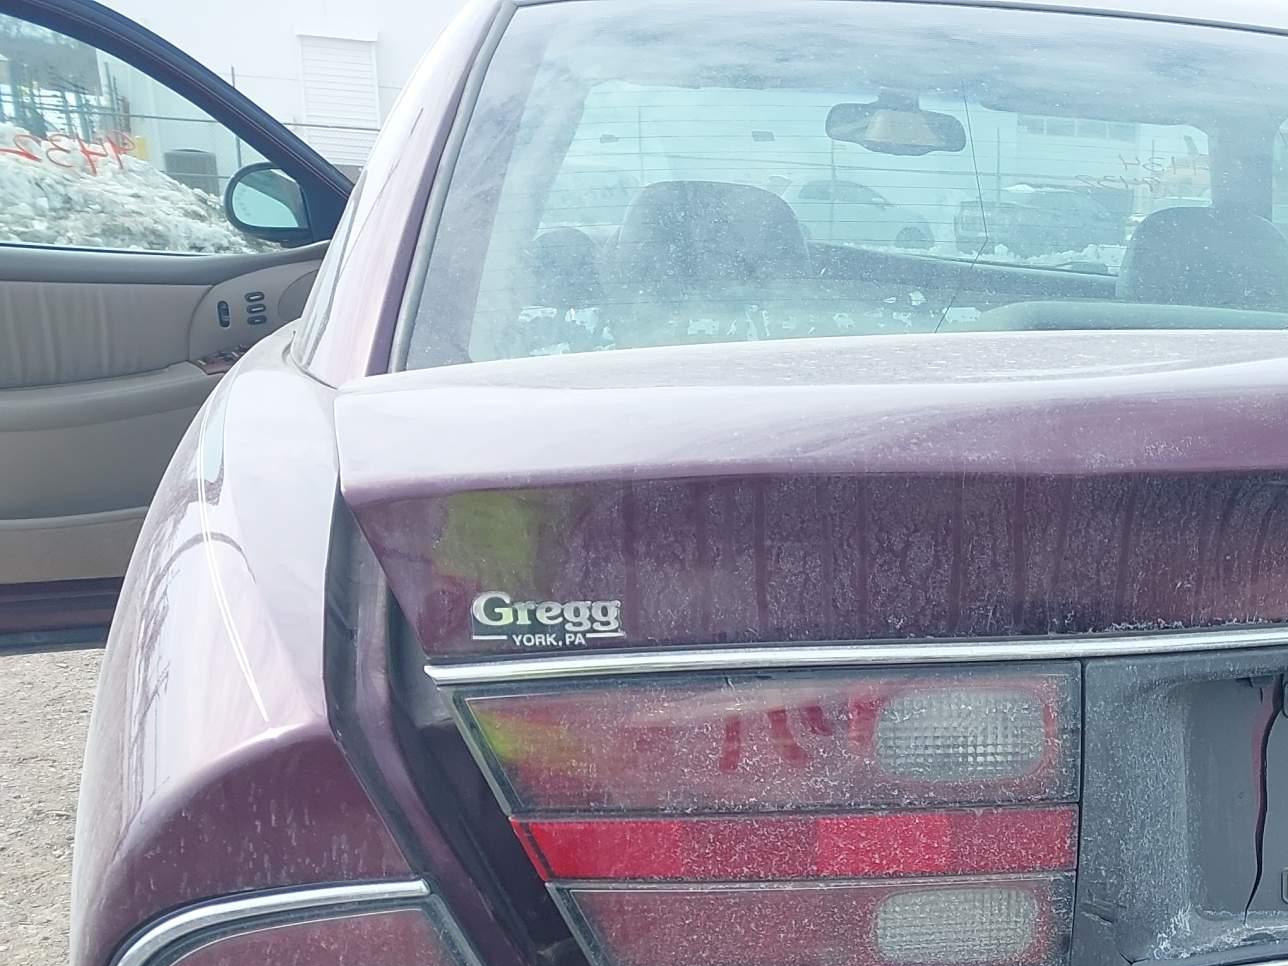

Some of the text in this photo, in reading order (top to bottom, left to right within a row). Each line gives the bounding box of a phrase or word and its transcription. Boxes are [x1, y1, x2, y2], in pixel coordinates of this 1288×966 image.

[472, 591, 622, 632] Gregg
[512, 632, 587, 647] YORK, PA
